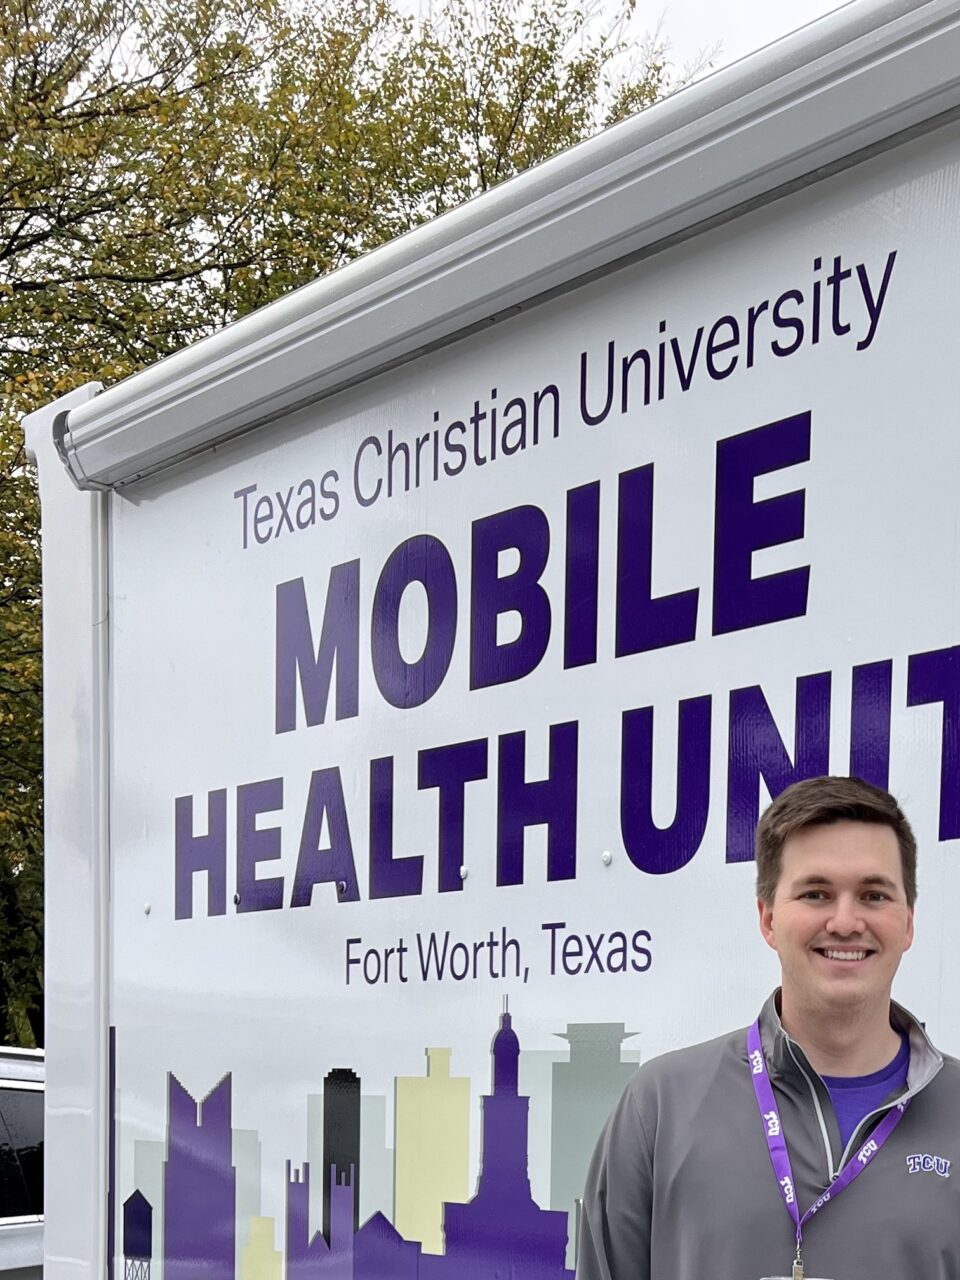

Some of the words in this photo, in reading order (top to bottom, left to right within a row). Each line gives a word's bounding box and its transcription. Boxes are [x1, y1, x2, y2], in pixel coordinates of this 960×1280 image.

[233, 470, 339, 550] Texas
[353, 384, 559, 507] Christian
[580, 250, 897, 426] University
[275, 410, 812, 735] MOBILE
[174, 720, 579, 921] HEALTH
[346, 937, 408, 985] Fort
[416, 926, 529, 984] Worth,
[541, 922, 653, 976] Texas
[749, 1049, 763, 1075] TCU
[763, 1110, 780, 1137] TCU
[857, 1139, 878, 1165] TCU
[906, 1153, 950, 1178] TCU
[779, 1175, 794, 1204] TCU
[810, 1192, 831, 1214] TCU
